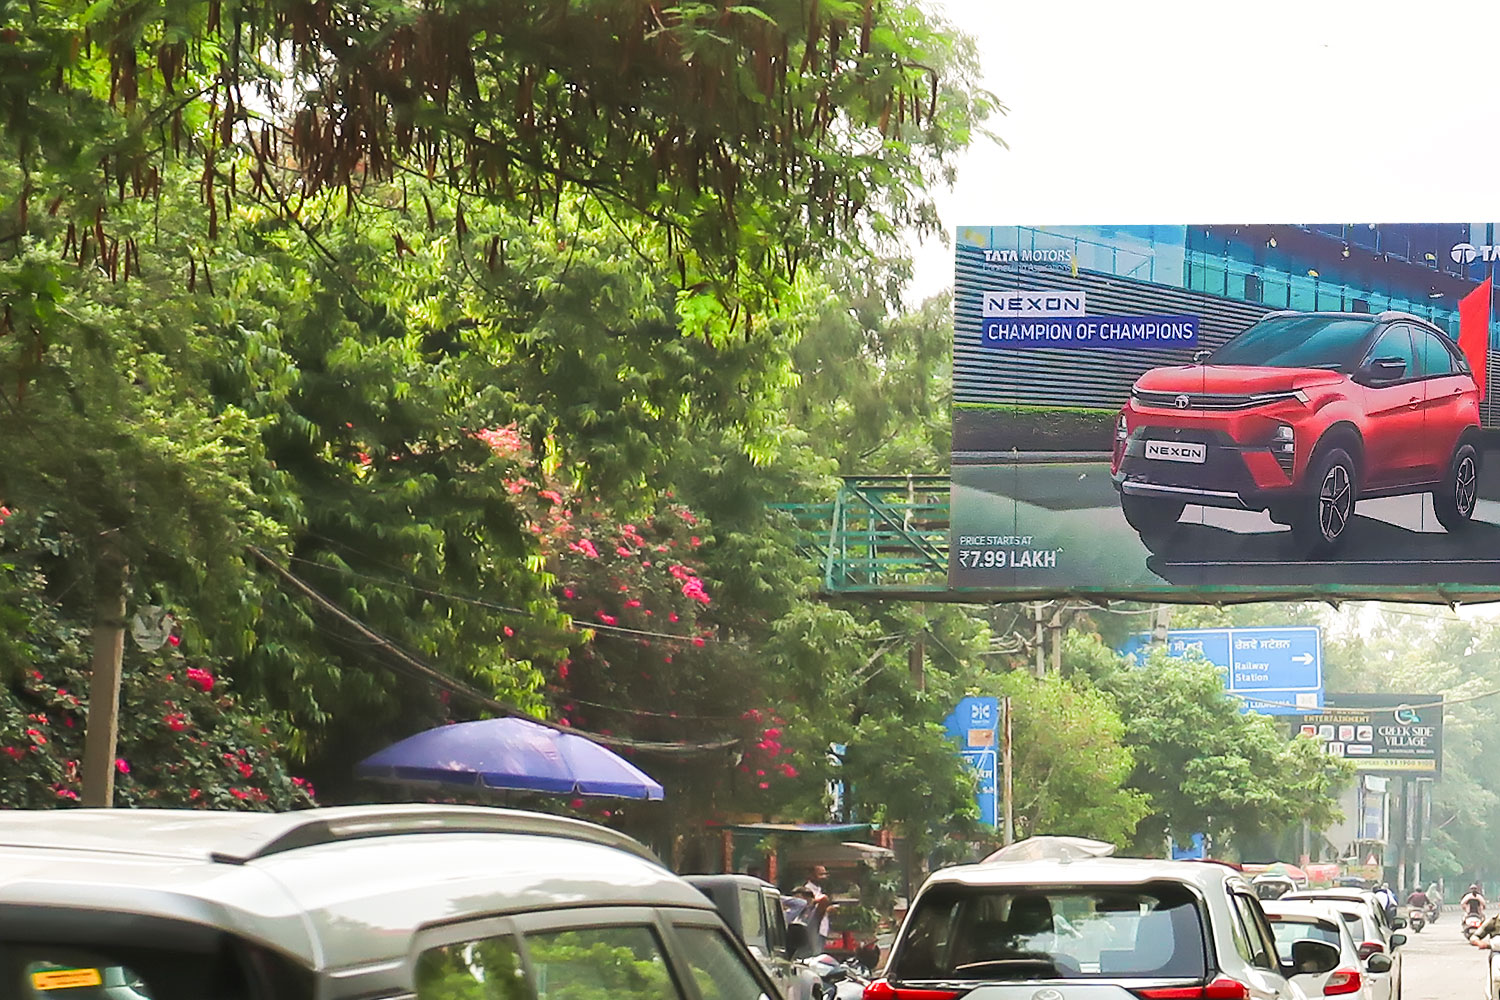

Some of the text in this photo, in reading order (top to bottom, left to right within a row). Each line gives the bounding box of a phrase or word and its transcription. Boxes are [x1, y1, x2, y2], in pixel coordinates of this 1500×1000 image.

[983, 249, 1071, 262] TATA MOTORS
[989, 298, 1080, 311] NEXON
[988, 323, 1193, 340] CHAMPION OF CHAMPIONS
[1149, 446, 1201, 458] NEXON
[960, 536, 1033, 545] PRICE STARTS AT
[959, 550, 1006, 568] ₹7.99
[1235, 662, 1270, 671] Railway
[1235, 674, 1269, 682] Station
[1377, 727, 1411, 737] CREEK
[1384, 737, 1427, 747] VILLAGE
